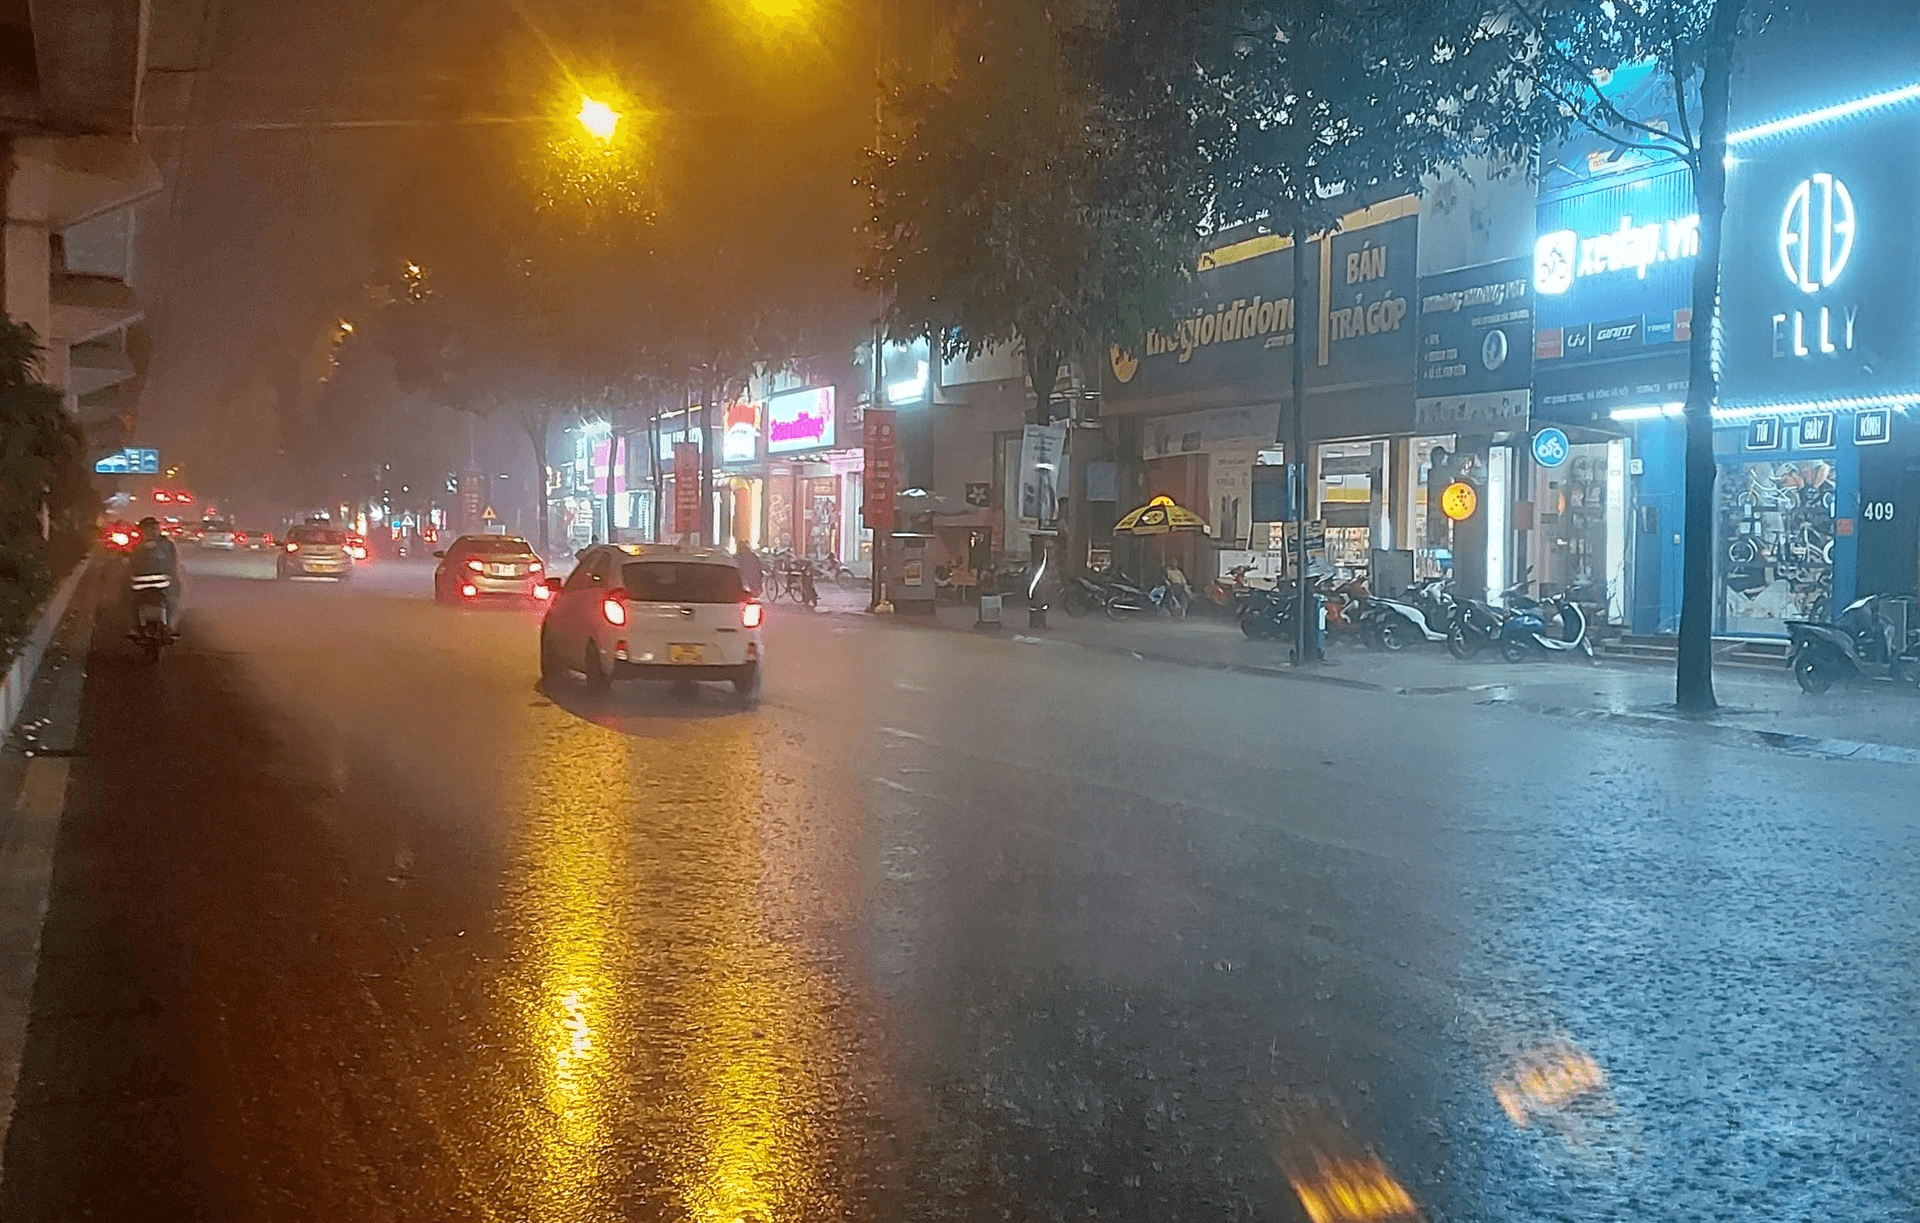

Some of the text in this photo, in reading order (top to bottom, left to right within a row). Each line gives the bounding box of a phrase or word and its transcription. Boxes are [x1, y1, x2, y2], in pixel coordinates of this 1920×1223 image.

[1346, 240, 1386, 285] BÁN
[1330, 293, 1364, 340] TRẢ
[1366, 290, 1406, 334] GÓP
[1596, 323, 1637, 341] GIANT
[1773, 304, 1858, 358] ELLY
[1756, 420, 1769, 443] TÚI
[1863, 502, 1894, 520] 409
